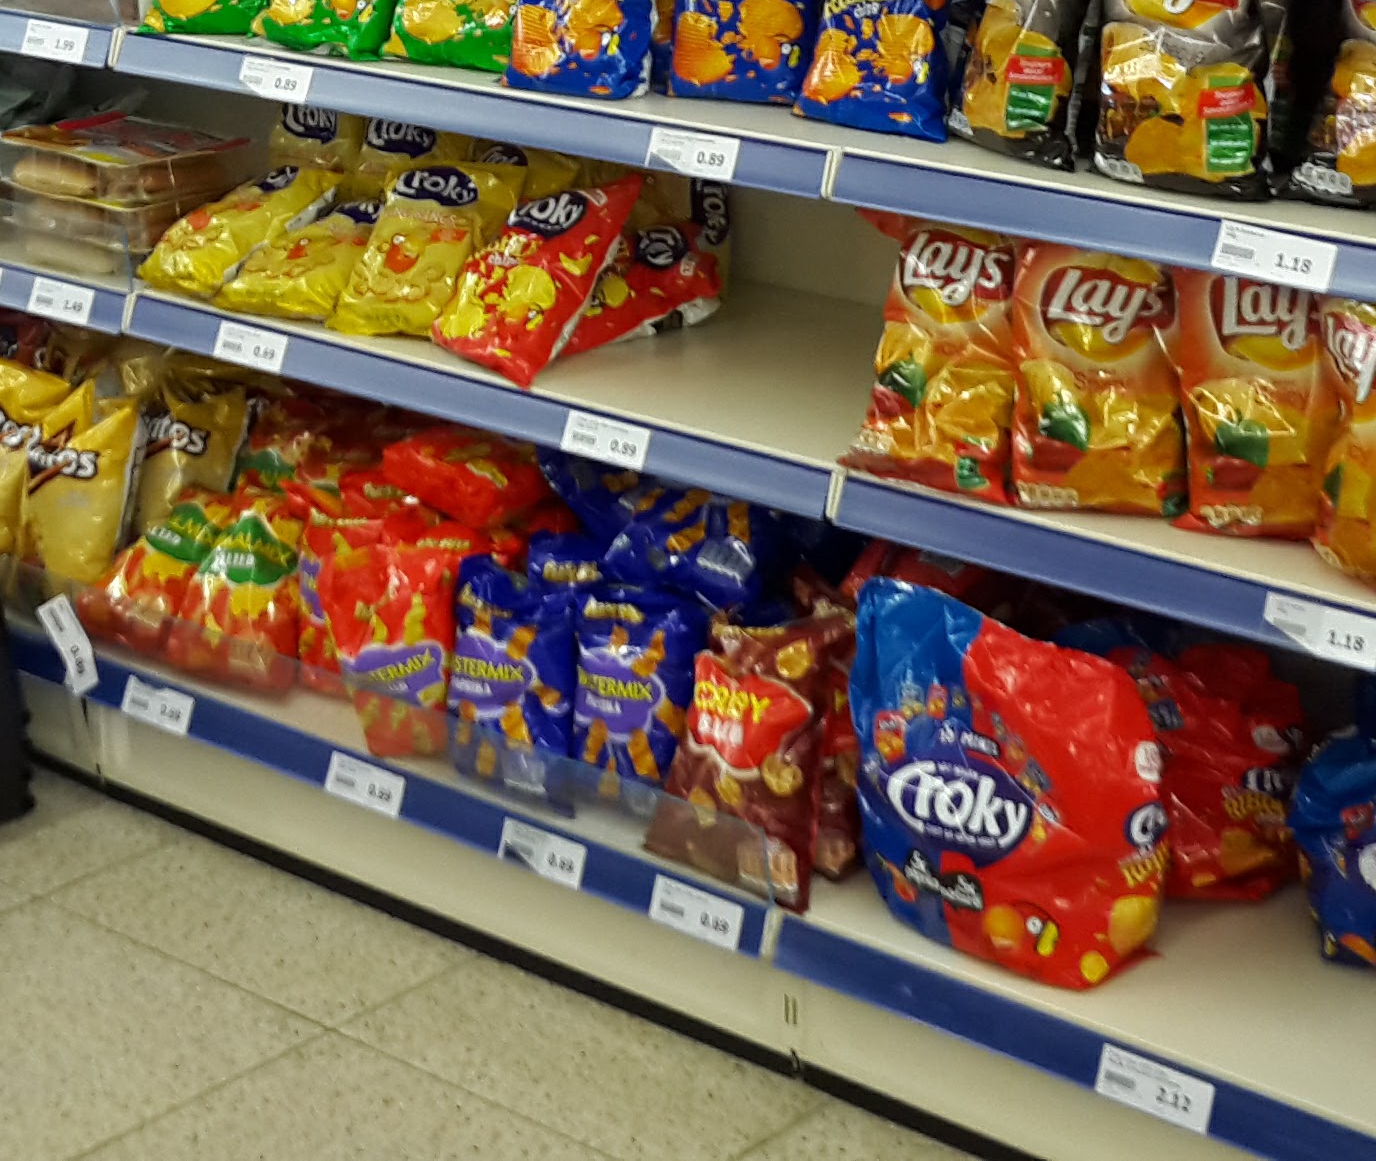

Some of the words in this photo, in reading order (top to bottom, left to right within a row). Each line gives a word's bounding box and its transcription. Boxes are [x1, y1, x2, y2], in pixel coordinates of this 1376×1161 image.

[396, 167, 478, 205] Croky
[902, 230, 1012, 306] Lay's
[1274, 252, 1312, 275] 1.18
[1047, 267, 1165, 344] Lay's
[1328, 628, 1366, 654] 1.18
[887, 760, 1028, 849] Croky
[1155, 1084, 1192, 1114] 2.12
